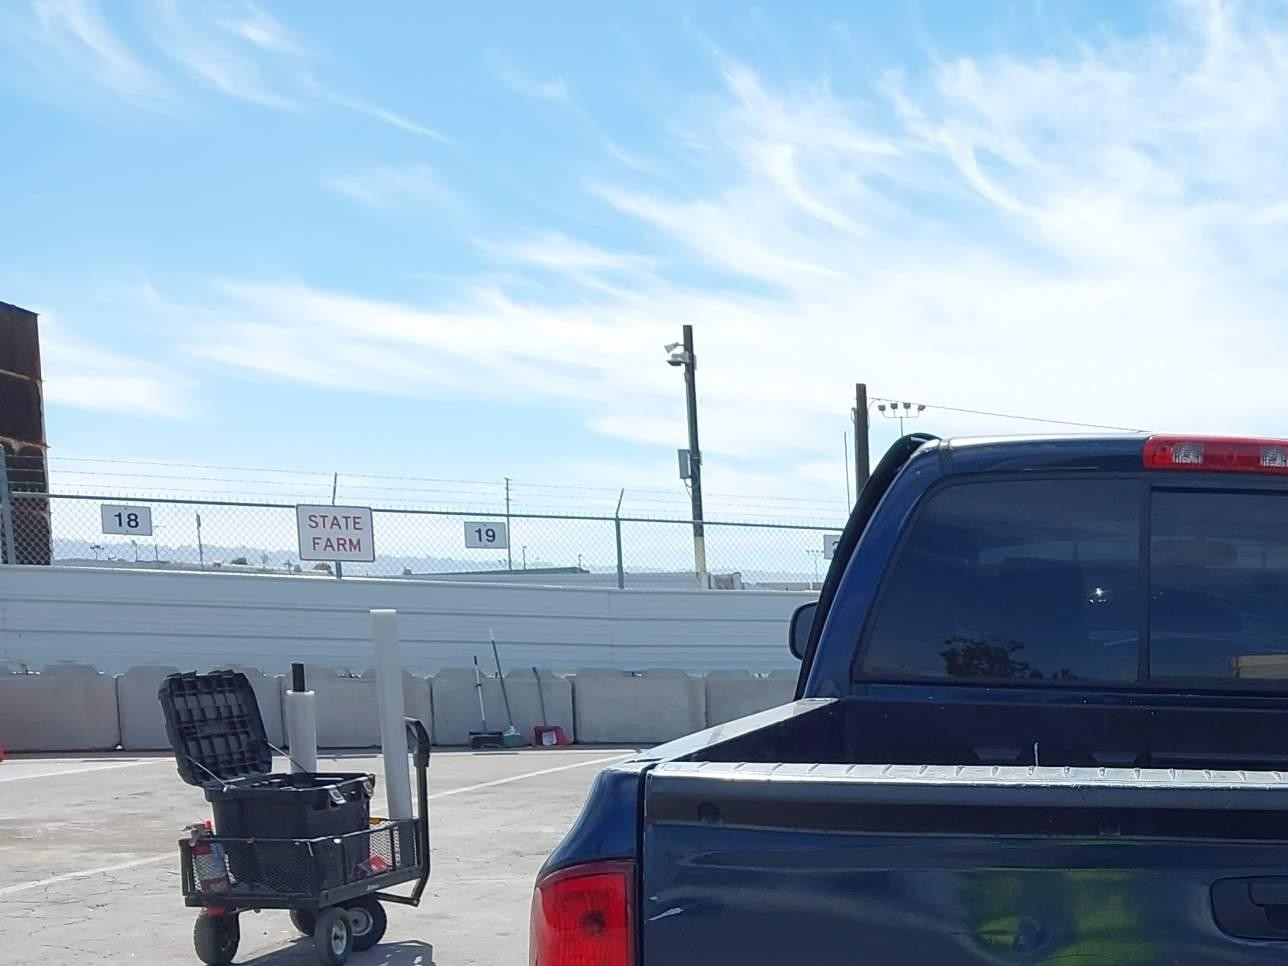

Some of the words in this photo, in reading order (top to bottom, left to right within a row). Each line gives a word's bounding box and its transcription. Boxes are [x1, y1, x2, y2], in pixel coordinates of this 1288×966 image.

[113, 512, 140, 529] 18
[308, 514, 363, 532] STATE
[474, 528, 496, 543] 19
[312, 536, 362, 553] FARM
